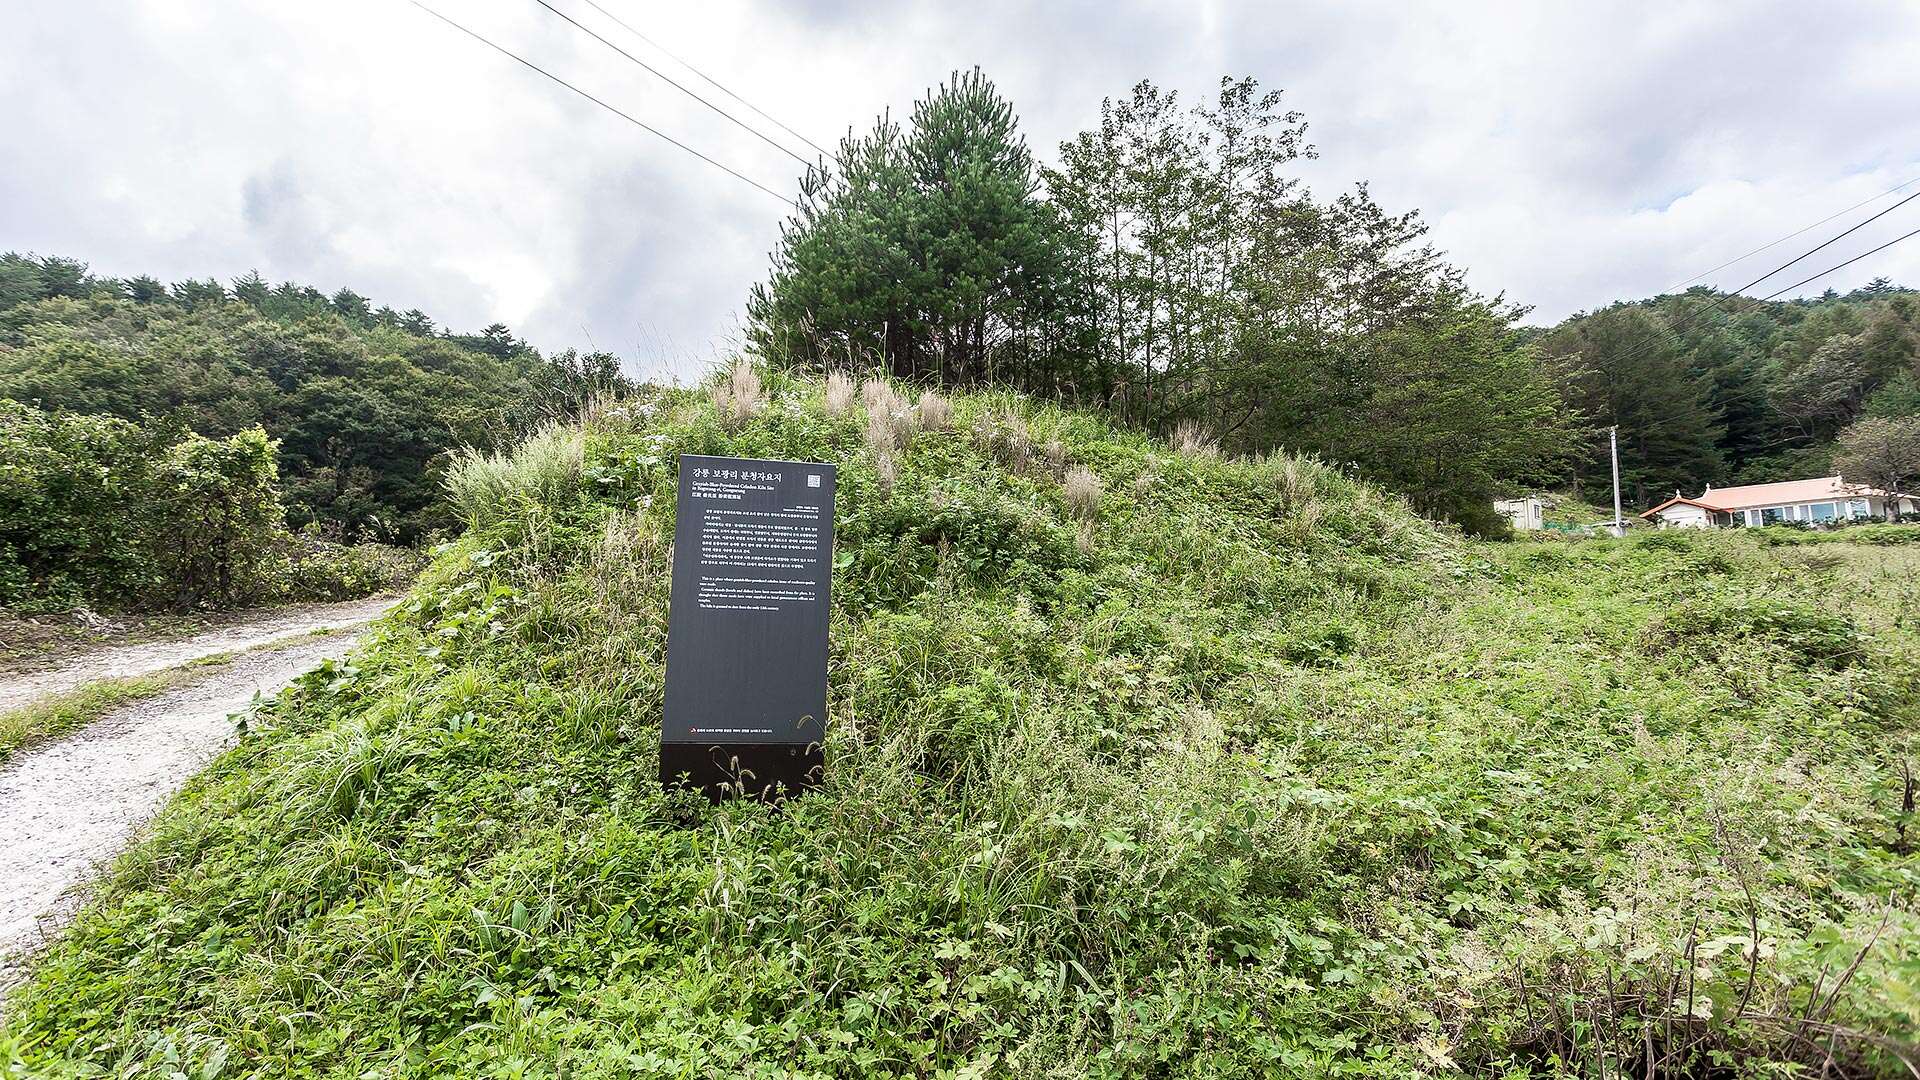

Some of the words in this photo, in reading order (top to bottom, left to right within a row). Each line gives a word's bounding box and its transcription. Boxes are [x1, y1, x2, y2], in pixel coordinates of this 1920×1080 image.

[692, 468, 710, 478] 강릉
[712, 470, 737, 480] 보광리
[740, 471, 782, 482] 분청자요지
